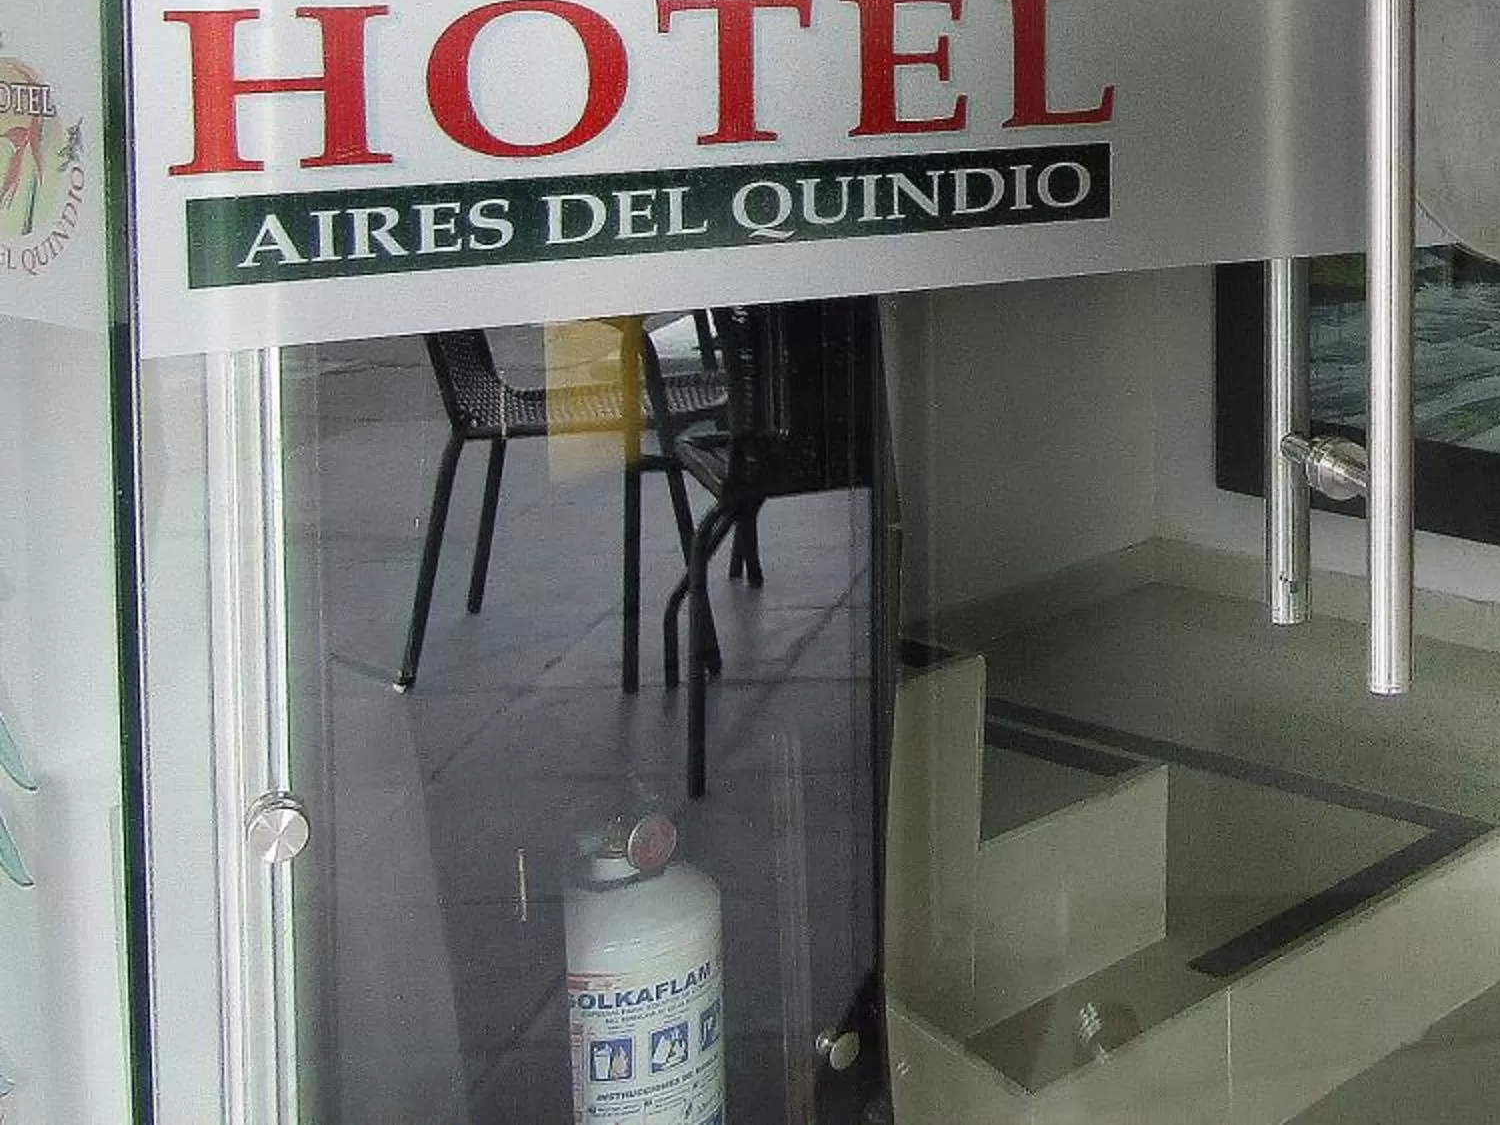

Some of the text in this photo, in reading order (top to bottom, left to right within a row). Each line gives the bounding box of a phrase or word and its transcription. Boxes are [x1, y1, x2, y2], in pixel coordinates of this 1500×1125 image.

[0, 81, 57, 117] OTEL
[21, 166, 85, 275] QUINDIO
[237, 160, 1093, 269] AIRES DEL QUINDIO
